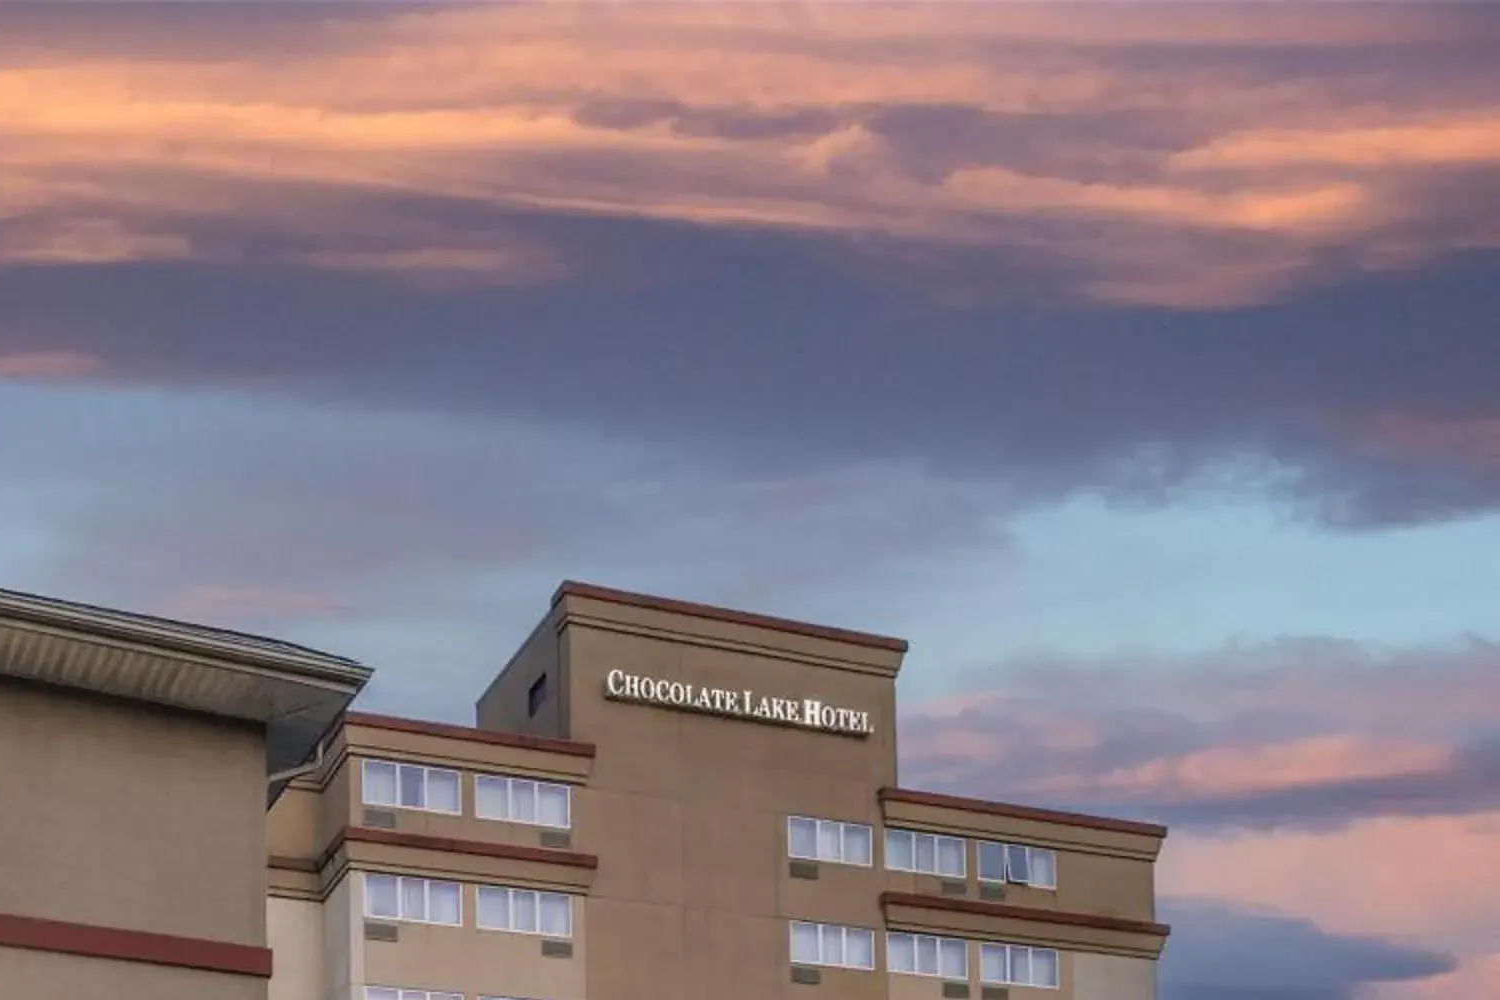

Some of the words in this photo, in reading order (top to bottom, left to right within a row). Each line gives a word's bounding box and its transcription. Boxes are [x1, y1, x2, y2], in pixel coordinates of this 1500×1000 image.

[607, 669, 738, 713] CHOCOLATE
[743, 690, 800, 720] LAKE
[802, 699, 874, 733] HOTEL
